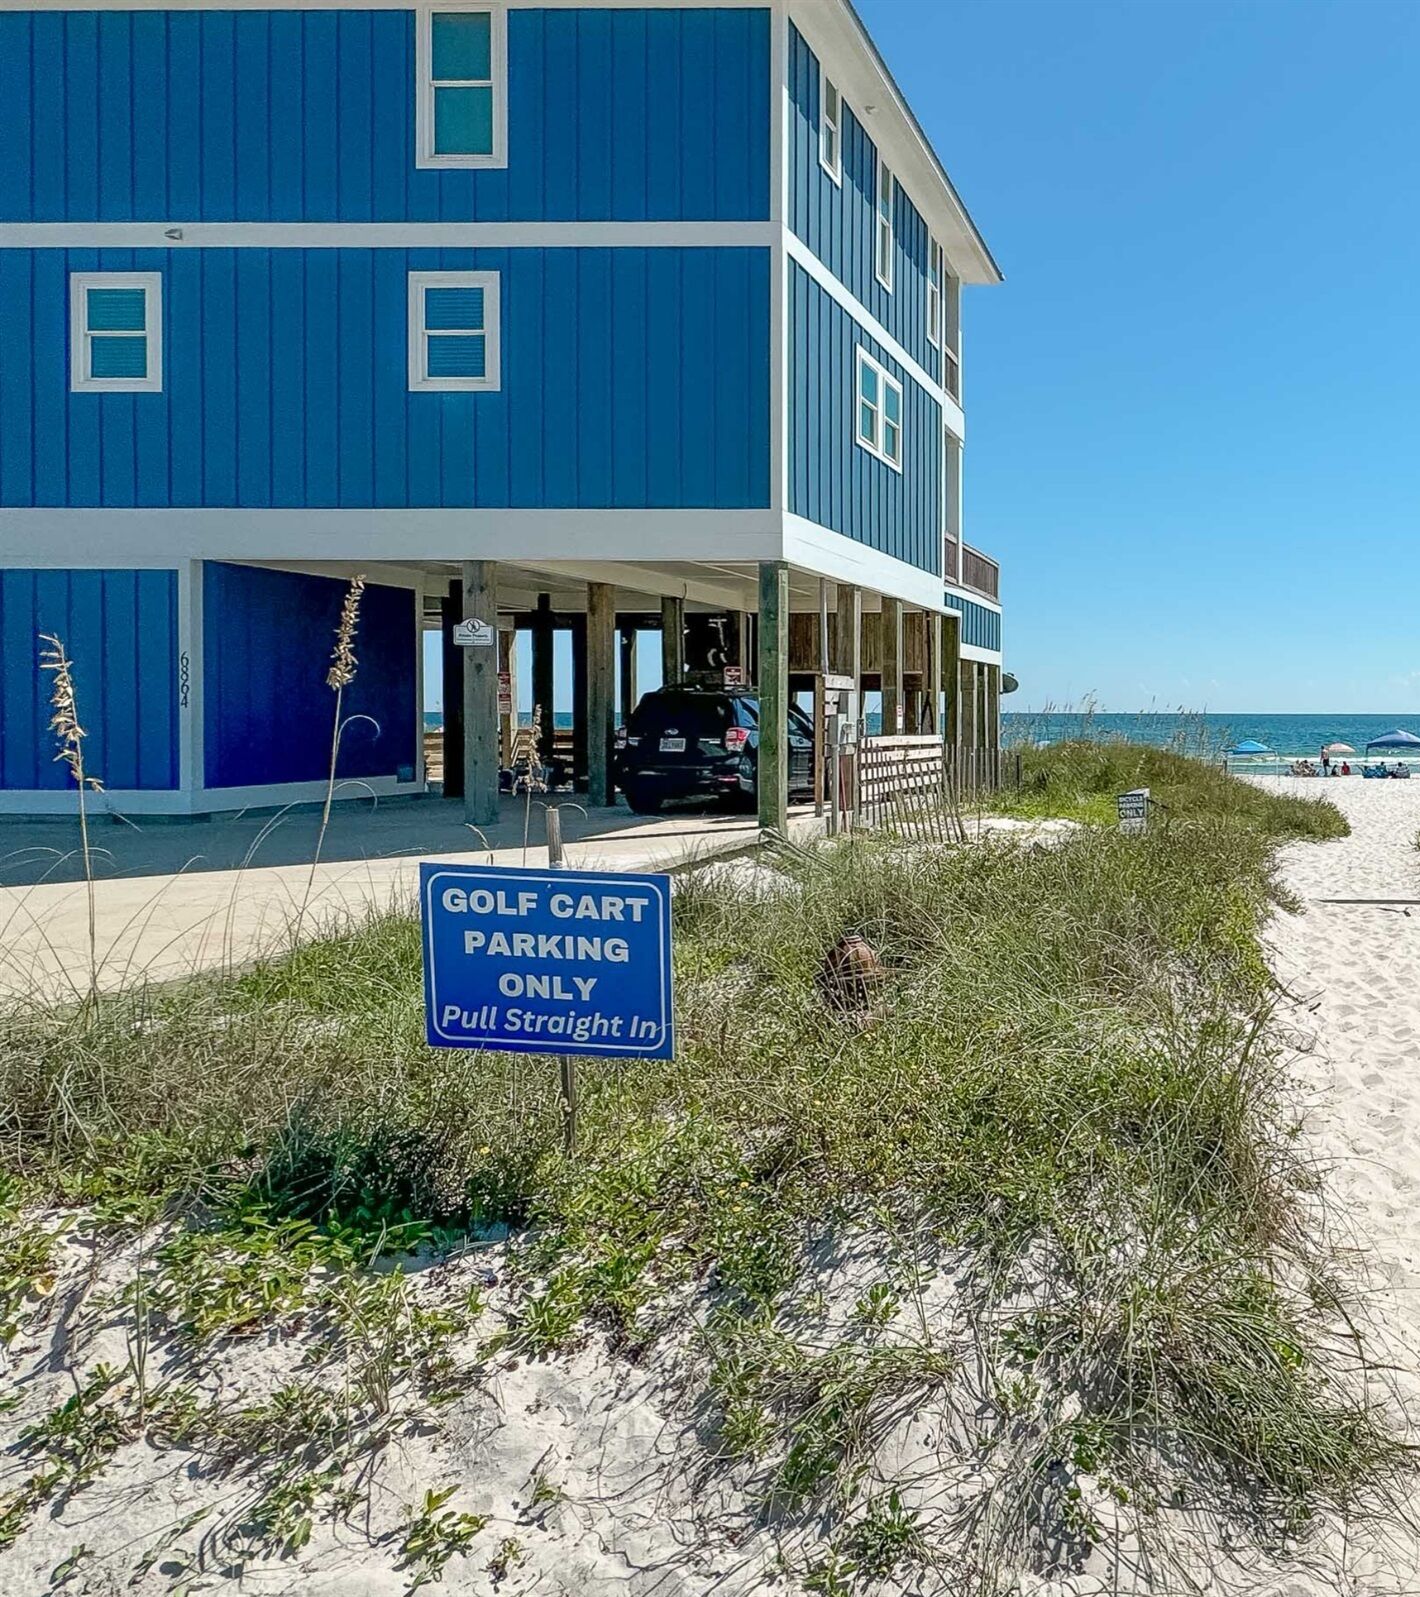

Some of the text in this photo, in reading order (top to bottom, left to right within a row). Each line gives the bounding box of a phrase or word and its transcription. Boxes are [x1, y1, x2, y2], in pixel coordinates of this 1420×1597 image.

[181, 651, 190, 708] 6864
[442, 888, 649, 922] GOLF CART
[464, 930, 629, 963] PARKING
[498, 973, 598, 1001] ONLY
[441, 1005, 658, 1042] Pull Straight In
